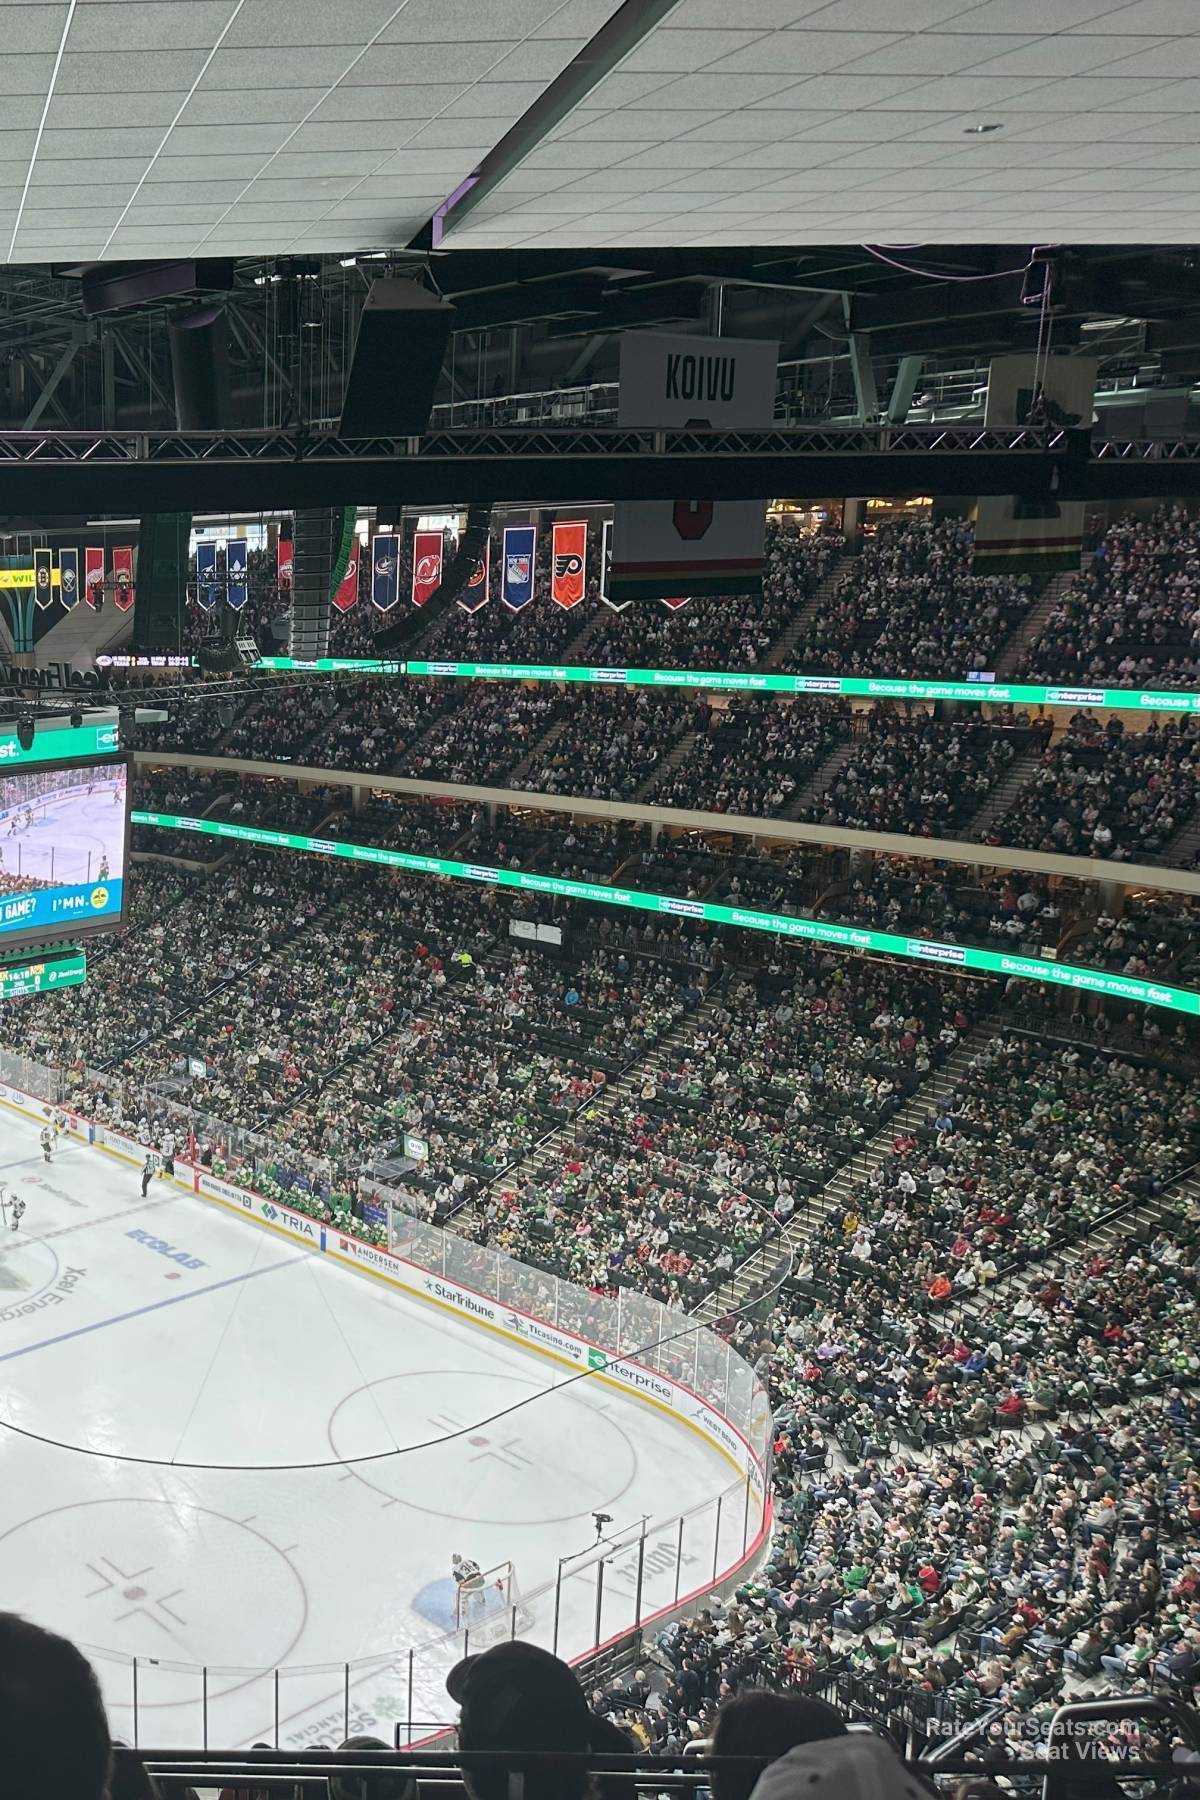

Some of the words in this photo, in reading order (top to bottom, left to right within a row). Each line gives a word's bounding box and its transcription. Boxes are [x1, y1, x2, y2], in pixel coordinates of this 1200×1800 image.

[666, 353, 736, 402] KOIVU
[12, 574, 35, 583] WIL
[654, 673, 686, 682] Because
[687, 674, 700, 683] the
[700, 676, 722, 687] game
[723, 677, 748, 686] moves
[796, 679, 841, 690] enterprise
[868, 681, 907, 692] Because
[908, 684, 925, 694] the
[926, 687, 954, 698] game
[954, 688, 987, 698] moves
[987, 687, 1011, 699] fast.
[1048, 691, 1104, 703] enterprise
[1140, 694, 1190, 707] Because
[462, 867, 498, 879] enterprise
[520, 876, 551, 889] Because
[552, 881, 565, 891] the
[565, 884, 587, 897] game
[587, 888, 612, 900] moves
[5, 897, 37, 920] GAME?
[659, 900, 704, 915] enterprise
[732, 912, 771, 928] Because
[772, 917, 788, 930] the
[789, 922, 816, 937] game
[817, 928, 848, 942] moves
[850, 929, 872, 945] fast.
[907, 943, 965, 961] enterprise
[1001, 958, 1050, 977] Because
[1051, 964, 1072, 981] the
[1072, 971, 1106, 989] game
[1106, 978, 1146, 997] moves
[1146, 984, 1173, 1003] fast.
[280, 1212, 314, 1237] TRIA
[127, 1229, 207, 1270] ECOLAB
[357, 1247, 399, 1271] ANDERSEN
[56, 1266, 88, 1295] Xcel
[434, 1283, 495, 1320] StarTribune
[703, 1417, 720, 1434] WEST
[721, 1431, 737, 1451] BEND
